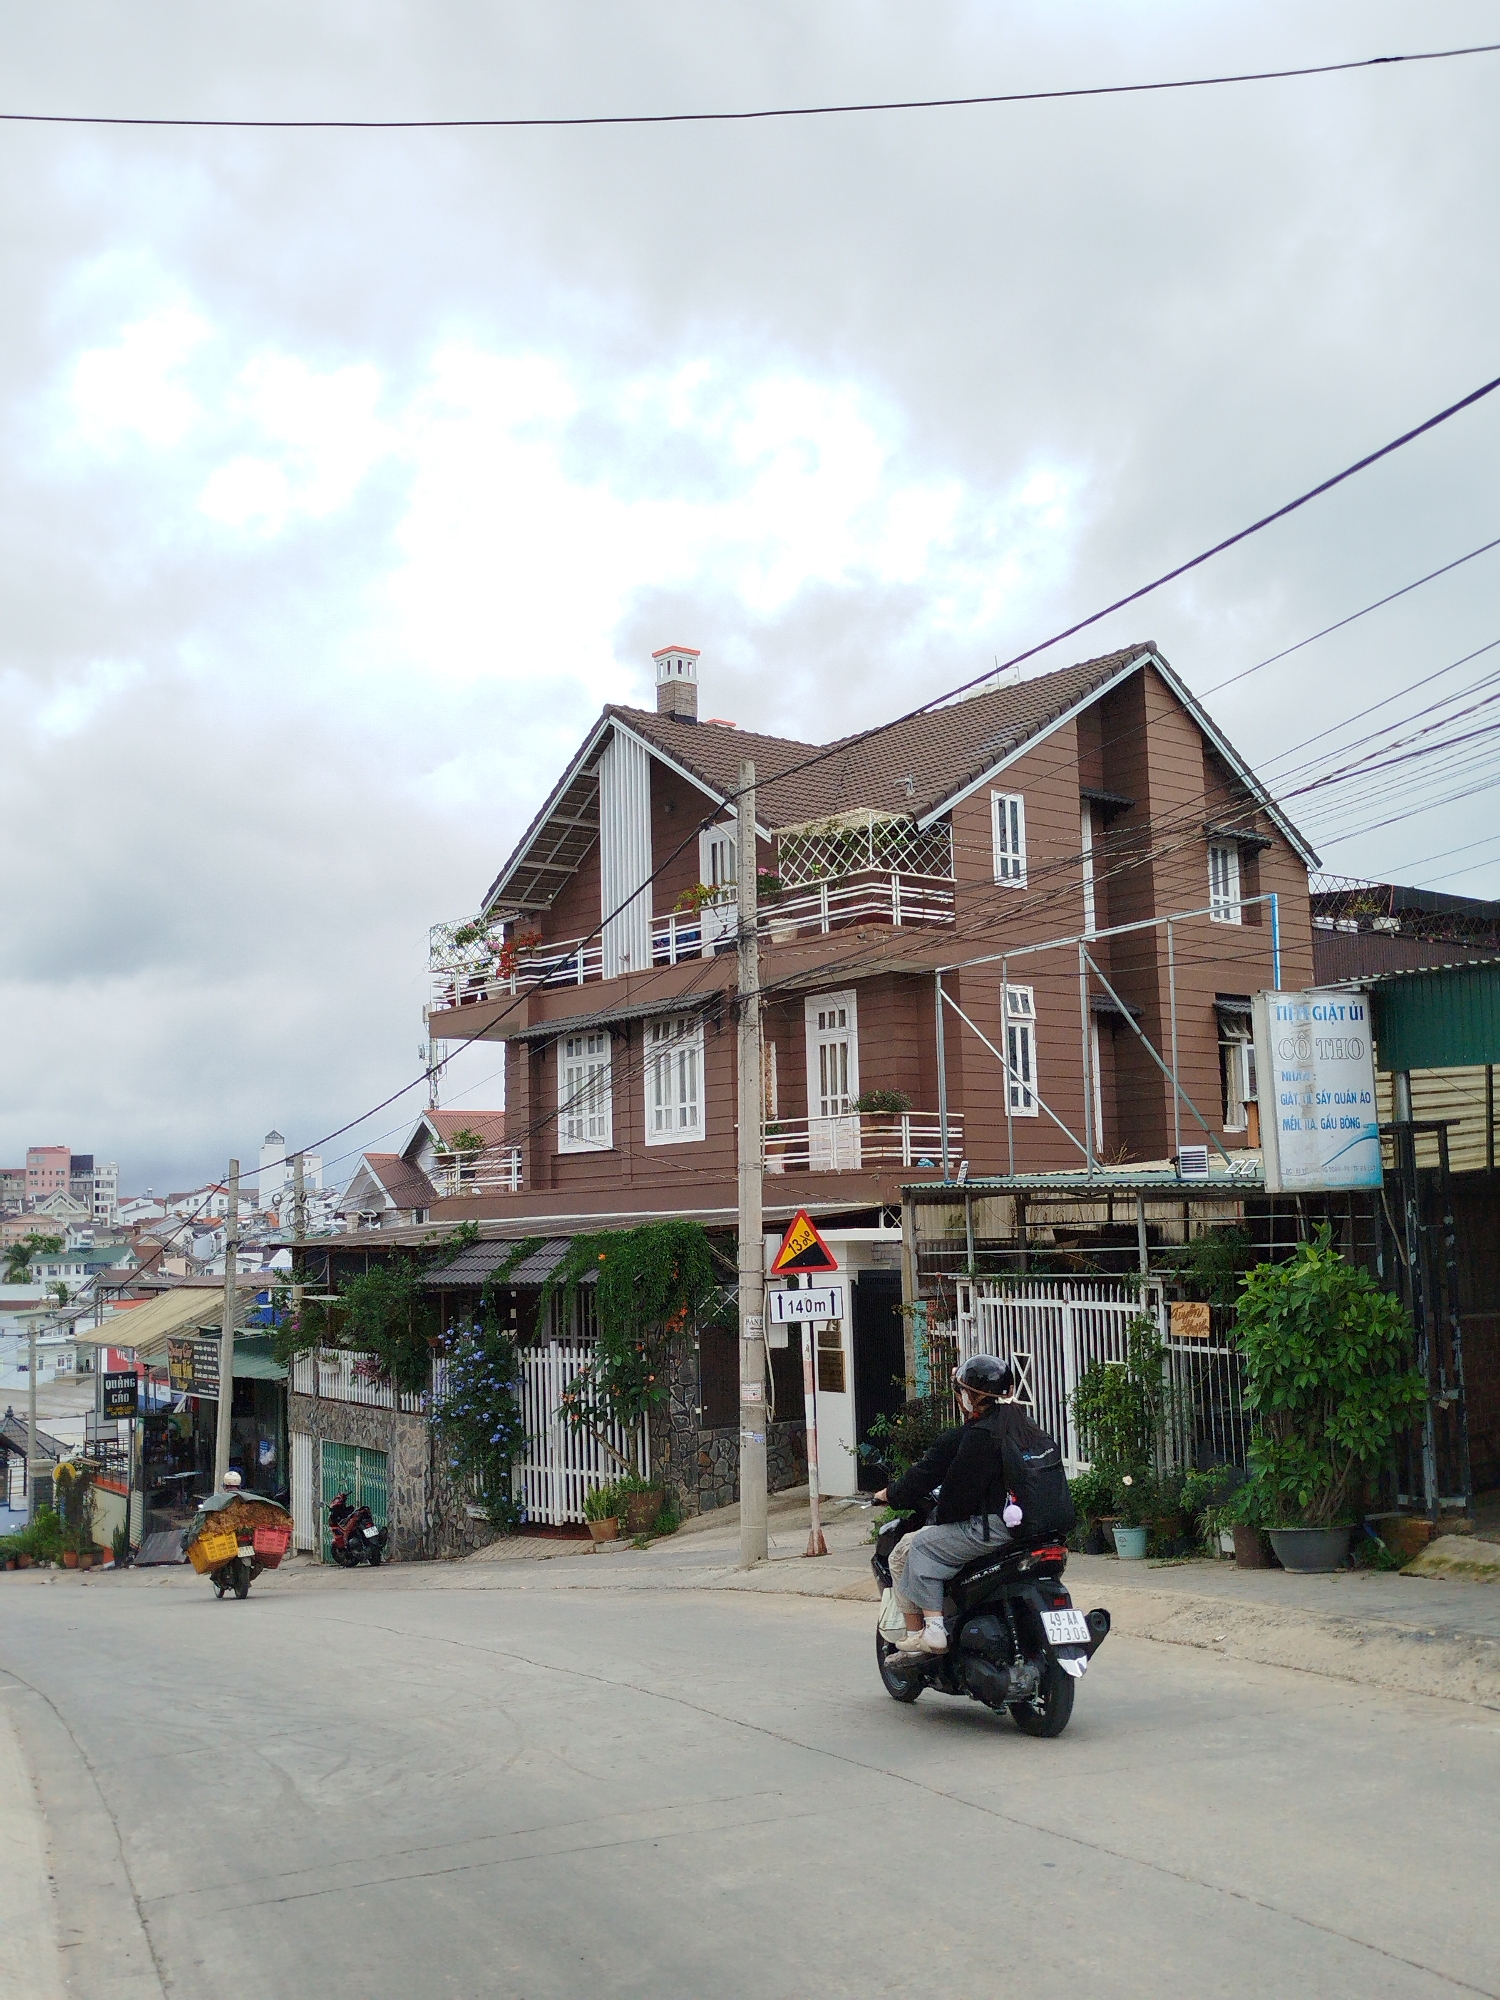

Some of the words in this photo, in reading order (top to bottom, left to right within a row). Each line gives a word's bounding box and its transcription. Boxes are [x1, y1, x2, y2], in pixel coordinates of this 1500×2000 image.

[1312, 1001, 1346, 1026] GIẶT
[1349, 1000, 1364, 1021] ỦI
[1278, 1031, 1312, 1061] CÔ
[1315, 1088, 1332, 1105] SẤY
[1360, 1088, 1371, 1104] ÁO
[1320, 1112, 1337, 1130] GẤU
[787, 1229, 813, 1255] 13%
[788, 1297, 826, 1315] 140m
[105, 1375, 136, 1390] QUẢNG
[1049, 1611, 1080, 1626] 49-AA
[1049, 1626, 1088, 1642] 273.06
